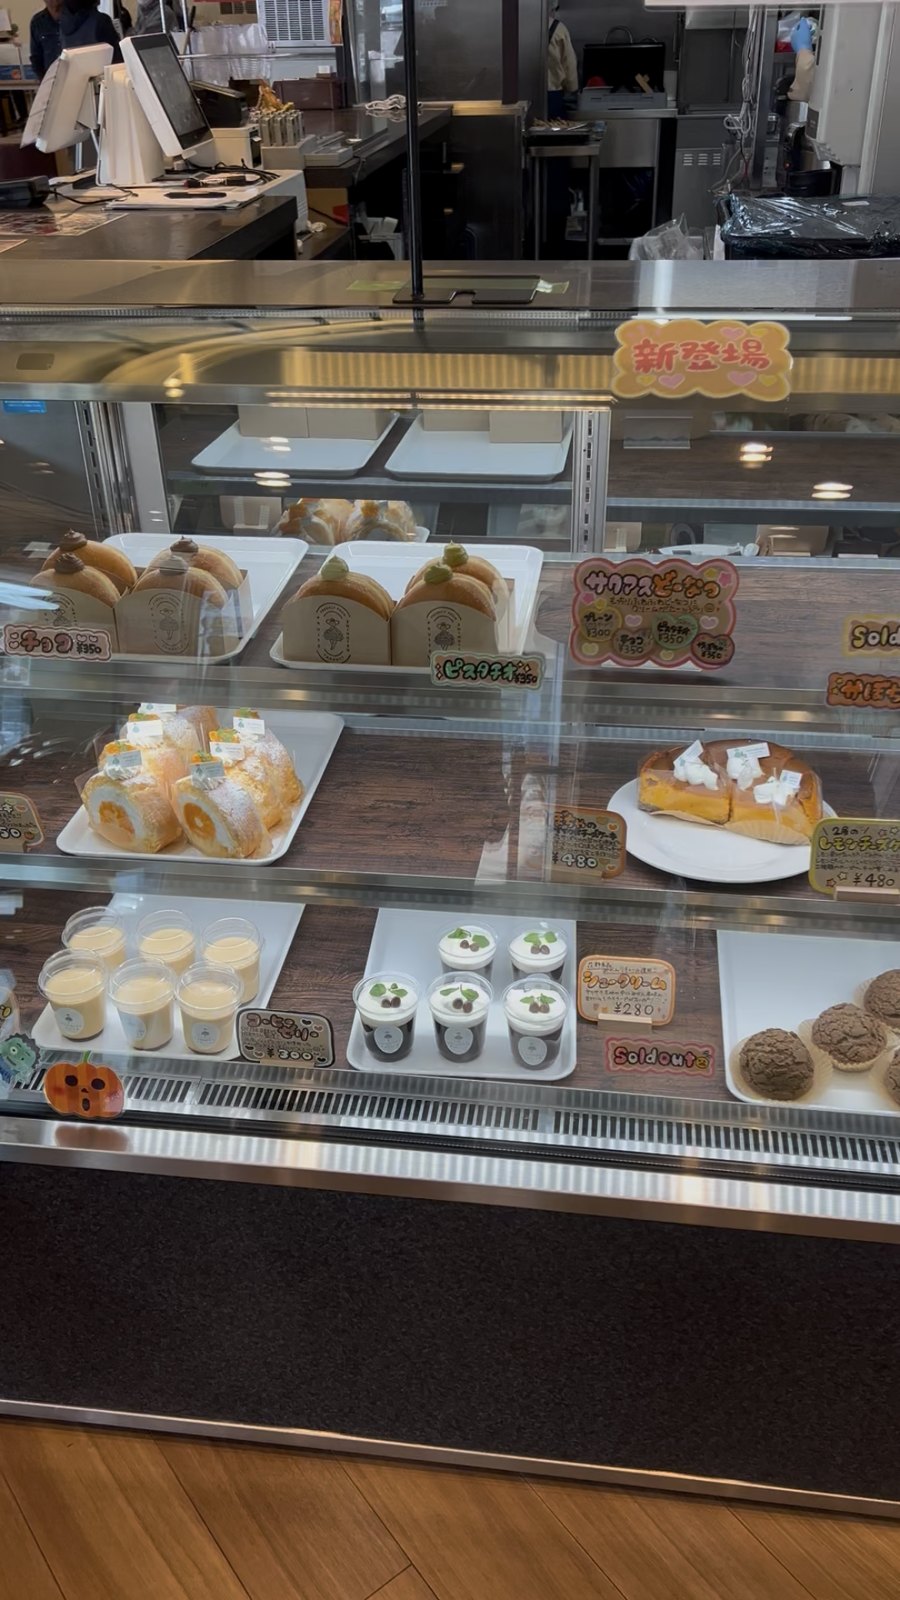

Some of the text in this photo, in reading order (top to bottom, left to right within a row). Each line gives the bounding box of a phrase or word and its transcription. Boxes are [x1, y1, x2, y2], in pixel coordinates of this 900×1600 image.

[632, 337, 772, 374] 新登場
[657, 620, 691, 636] ピスタチオ
[20, 629, 102, 654] チョコ ¥350
[619, 634, 645, 645] チョコ
[443, 657, 538, 684] ピスタチオ ¥350
[552, 852, 598, 868] ¥480
[853, 872, 895, 888] ¥480
[583, 971, 667, 991] シュークリーム
[613, 1002, 654, 1016] ¥280
[246, 1012, 295, 1028] コーヒー
[277, 1024, 319, 1041] ゼリー
[267, 1047, 313, 1061] ¥300
